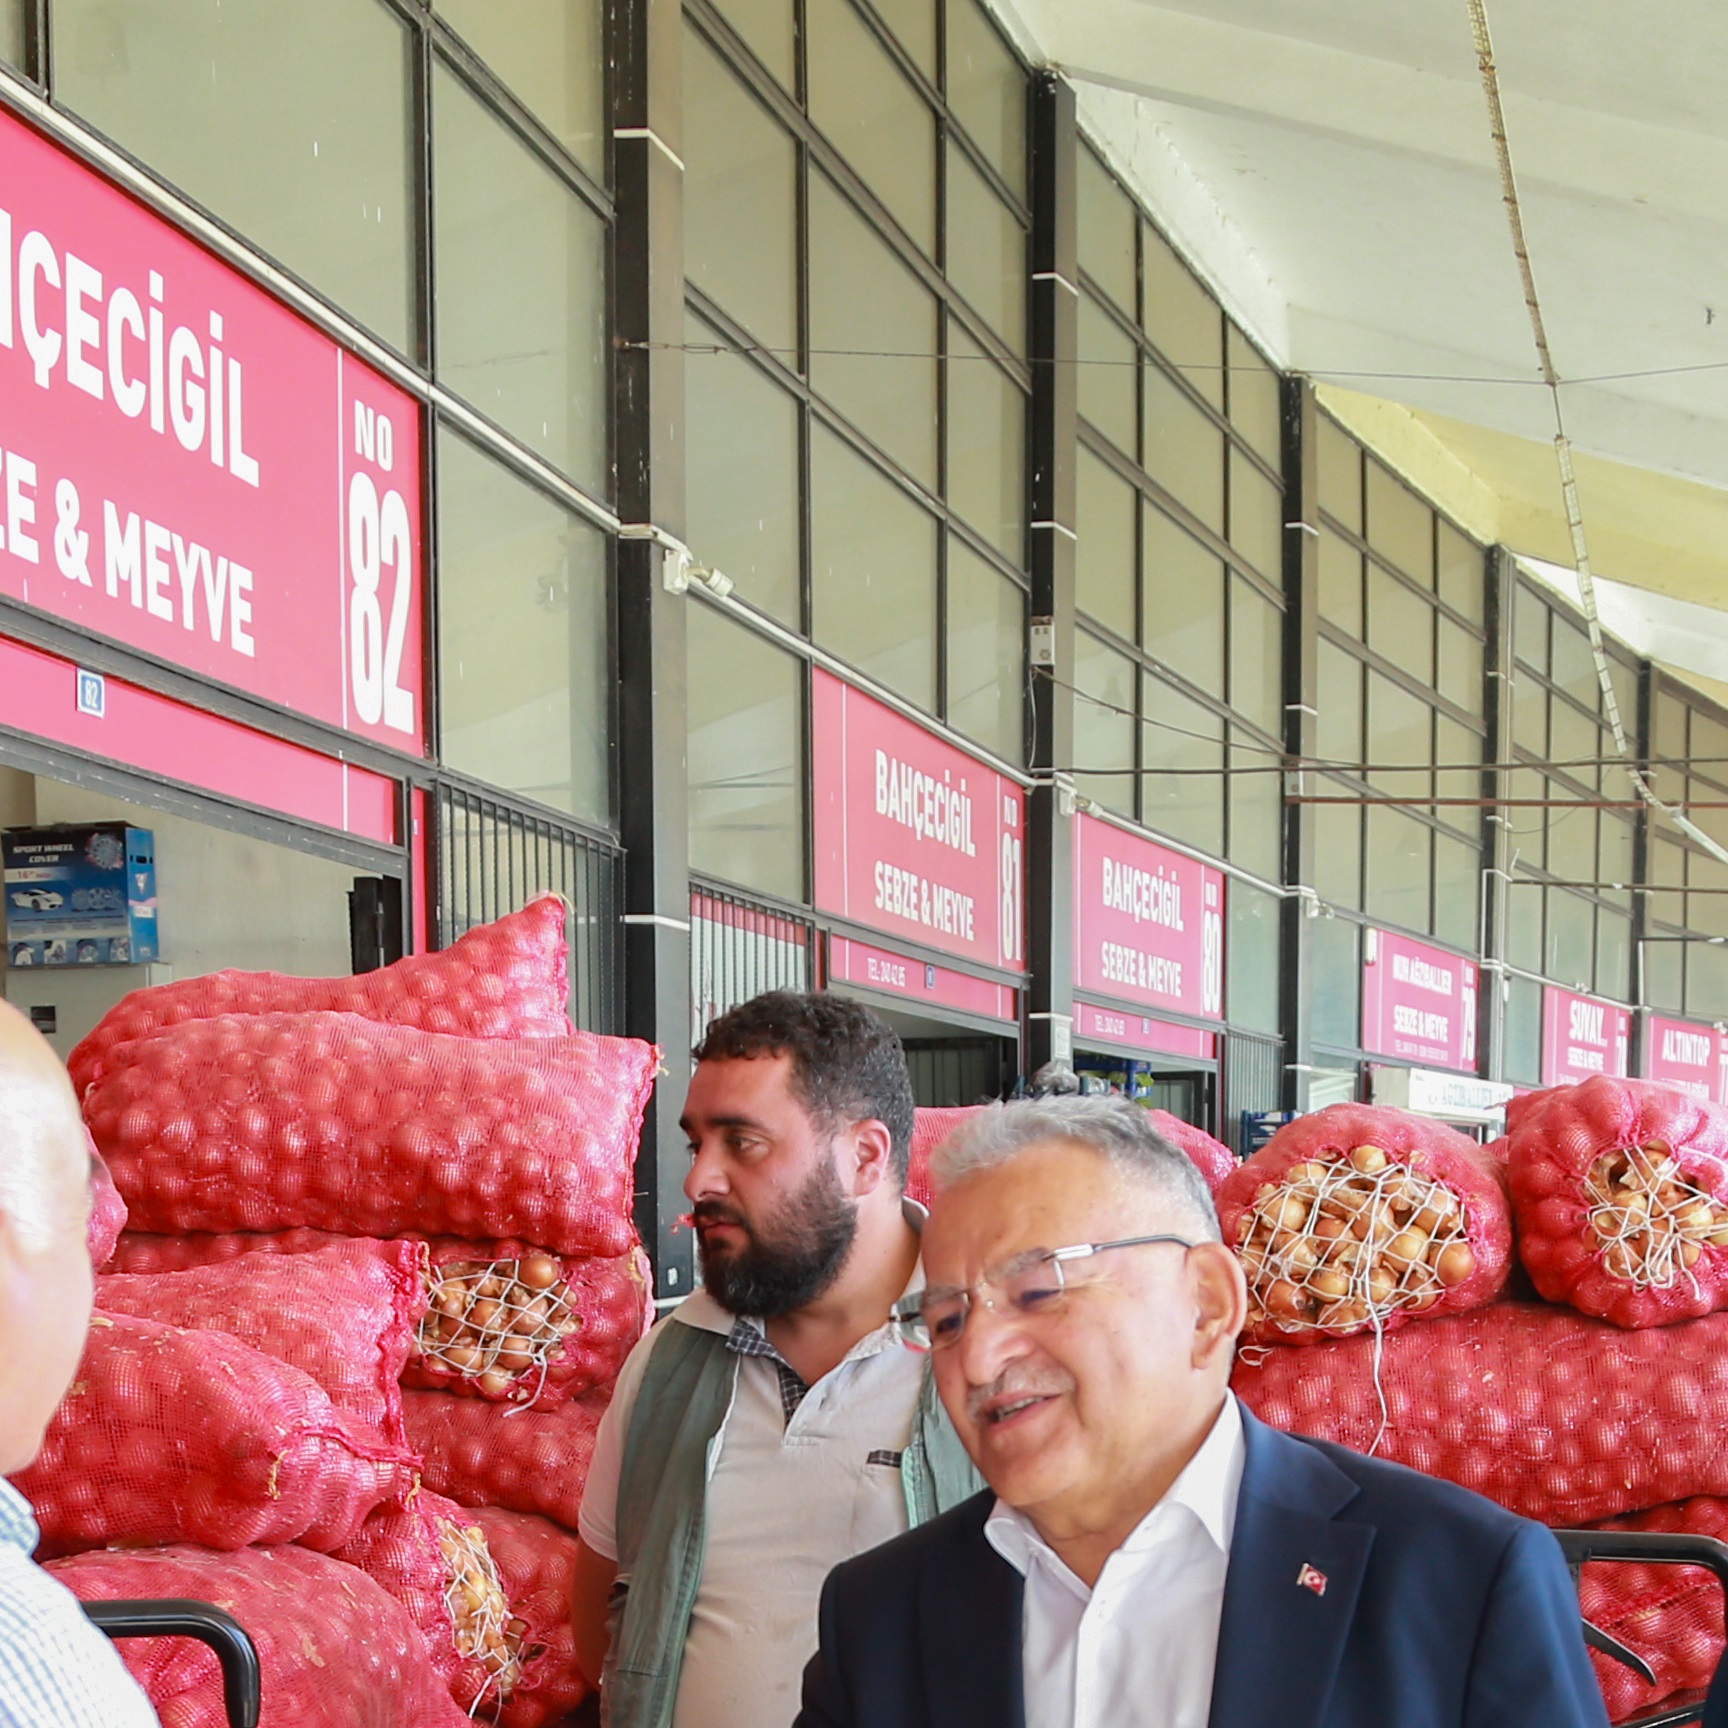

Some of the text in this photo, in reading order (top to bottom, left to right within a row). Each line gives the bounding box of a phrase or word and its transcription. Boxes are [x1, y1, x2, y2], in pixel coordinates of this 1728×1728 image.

[354, 400, 394, 472] NO
[54, 478, 93, 589] &
[103, 500, 256, 658] MEYVE
[348, 472, 415, 734] 82
[82, 678, 100, 708] 82
[875, 748, 976, 858] BAHÇECİGİL
[1003, 795, 1018, 827] NO
[28, 854, 60, 864] COVER
[1002, 832, 1022, 962] 81
[1102, 856, 1184, 932] BAHÇECİGİL
[875, 860, 974, 942] SEBZE & MEYVE
[1101, 941, 1182, 998] SEBZE & MEYVE
[1203, 910, 1221, 1014] 80
[1661, 1028, 1711, 1067] ALTINTOP
